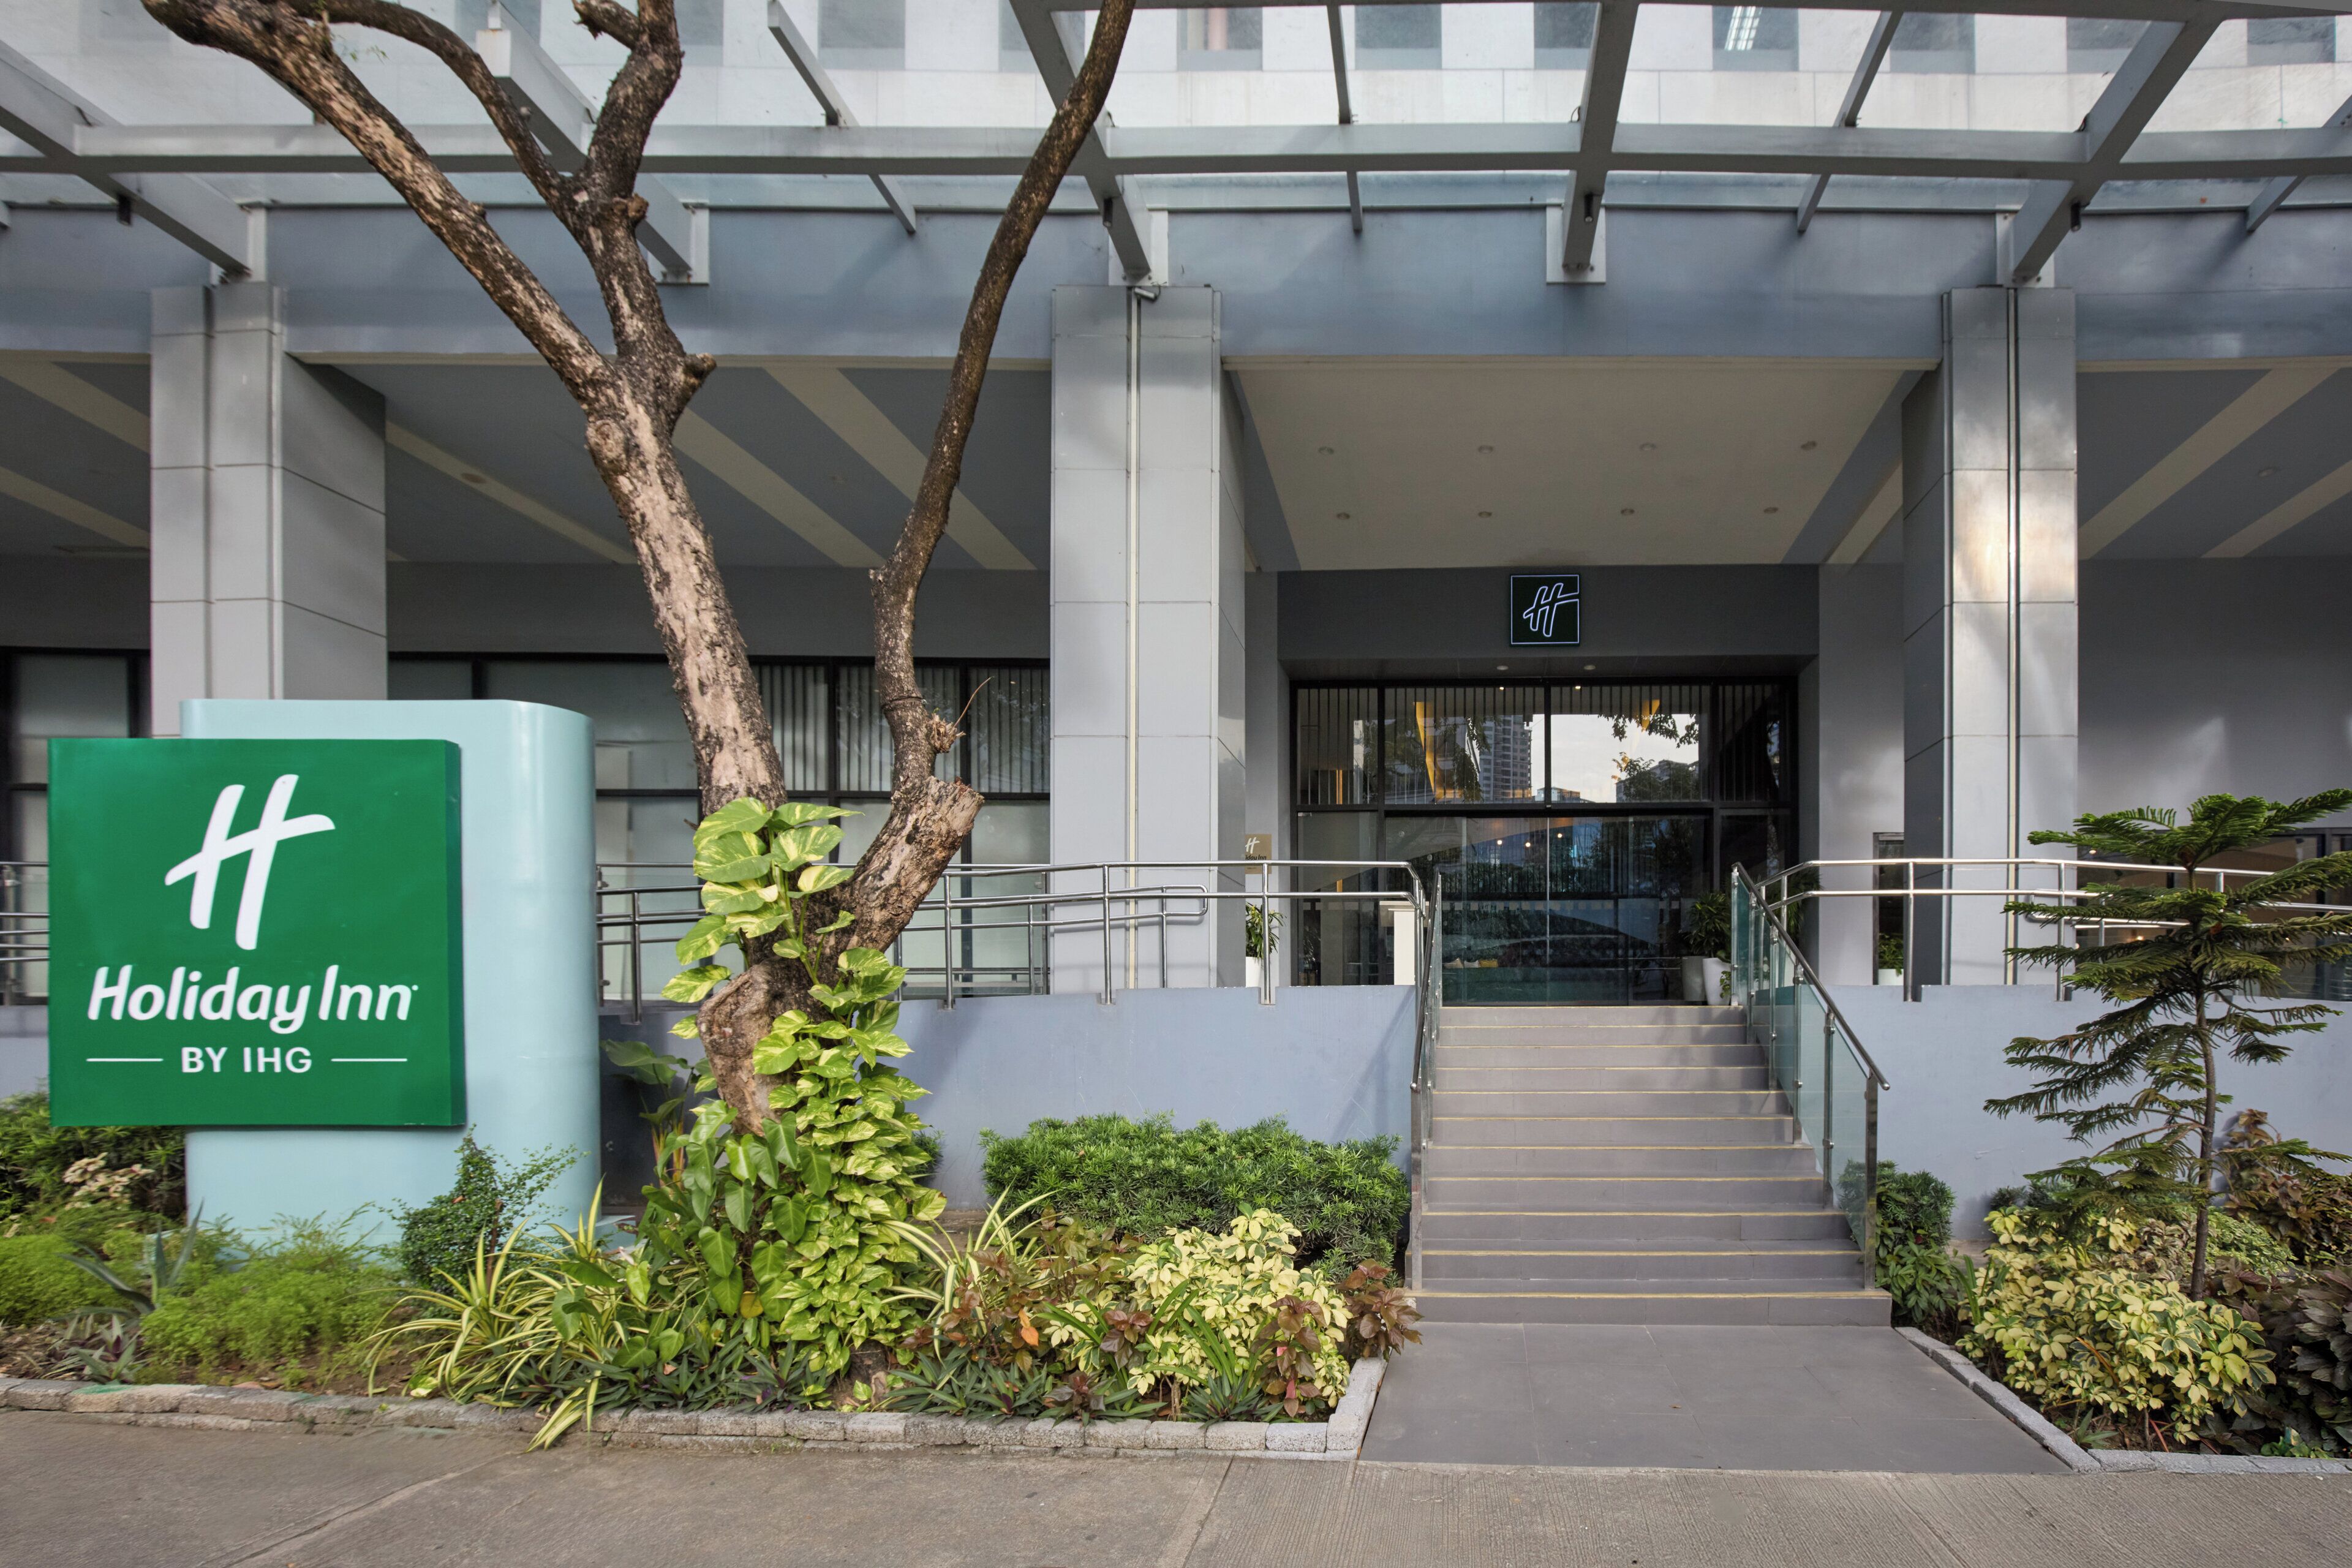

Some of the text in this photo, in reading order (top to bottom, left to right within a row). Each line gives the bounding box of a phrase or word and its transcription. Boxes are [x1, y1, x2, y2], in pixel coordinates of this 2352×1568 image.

[165, 774, 334, 950] H
[1245, 837, 1260, 854] H
[88, 965, 411, 1034] Holiday Inn
[182, 1047, 311, 1072] BY IHG
